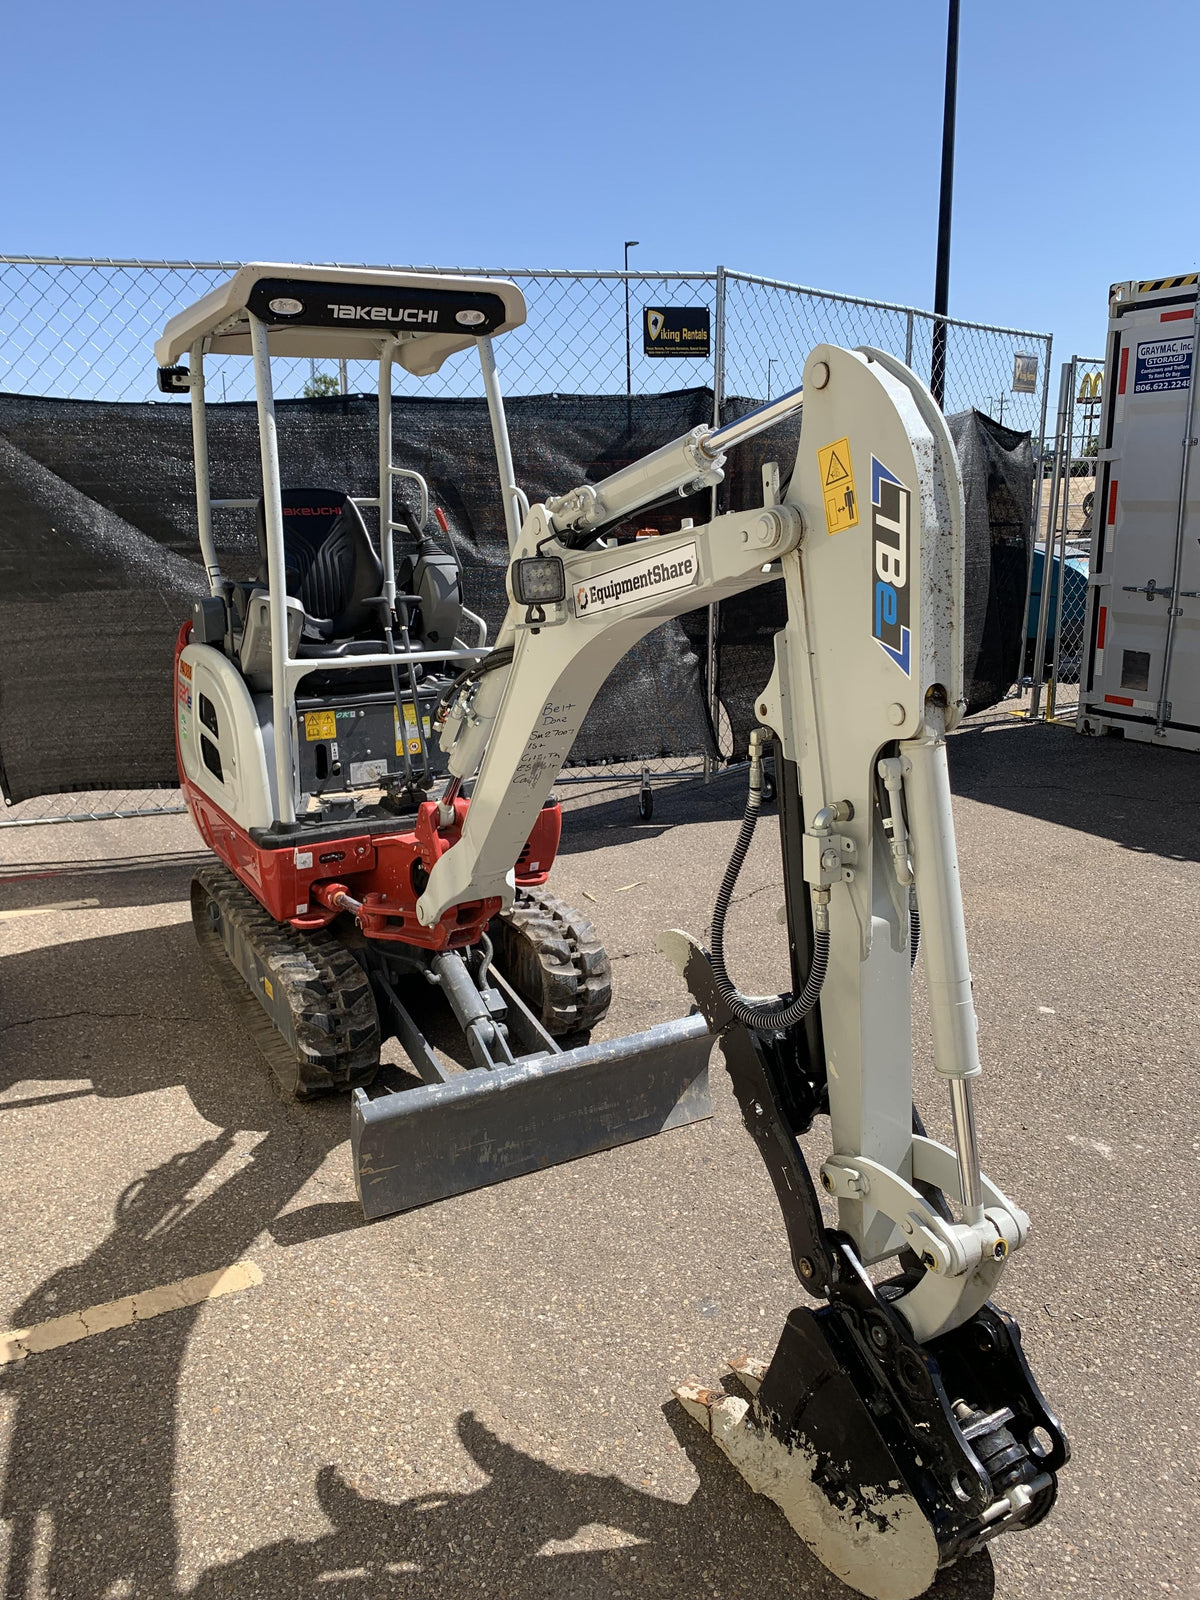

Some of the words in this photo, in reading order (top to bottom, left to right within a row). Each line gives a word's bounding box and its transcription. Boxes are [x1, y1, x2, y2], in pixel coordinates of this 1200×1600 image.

[682, 328, 707, 340] Rentals
[1141, 343, 1178, 356] GRAYMAC,
[1180, 342, 1193, 351] Inc.
[1148, 355, 1183, 364] STORAGE
[282, 506, 342, 516] AKEUCHI
[589, 558, 693, 605] EquipmentShare
[542, 703, 576, 716] Belt
